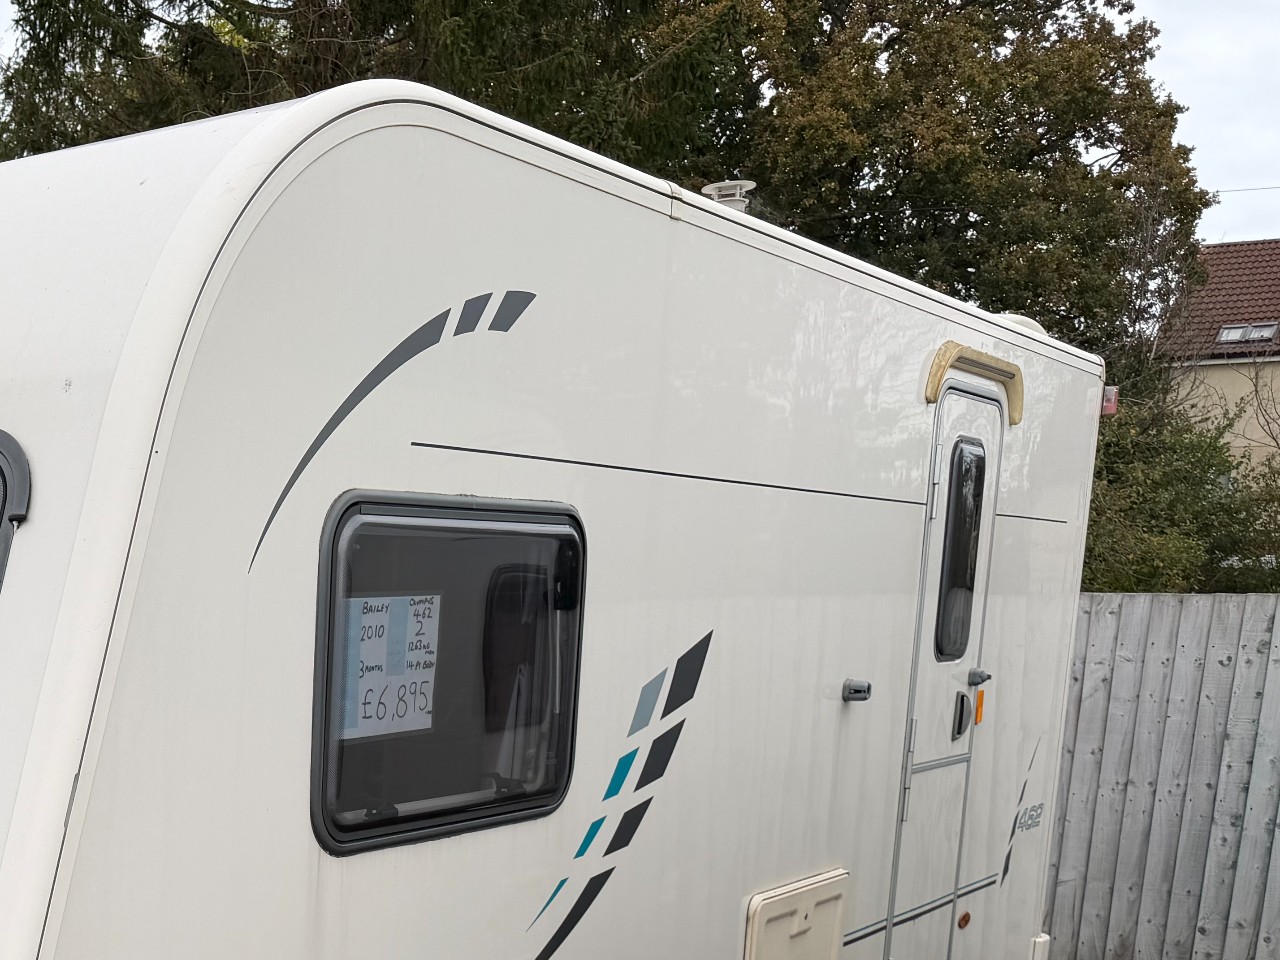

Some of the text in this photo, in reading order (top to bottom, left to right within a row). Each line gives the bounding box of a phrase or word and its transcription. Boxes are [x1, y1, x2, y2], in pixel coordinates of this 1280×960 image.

[413, 607, 433, 620] 462
[360, 625, 385, 641] 2010
[415, 620, 425, 636] 2
[359, 660, 383, 678] 3 MONTHS
